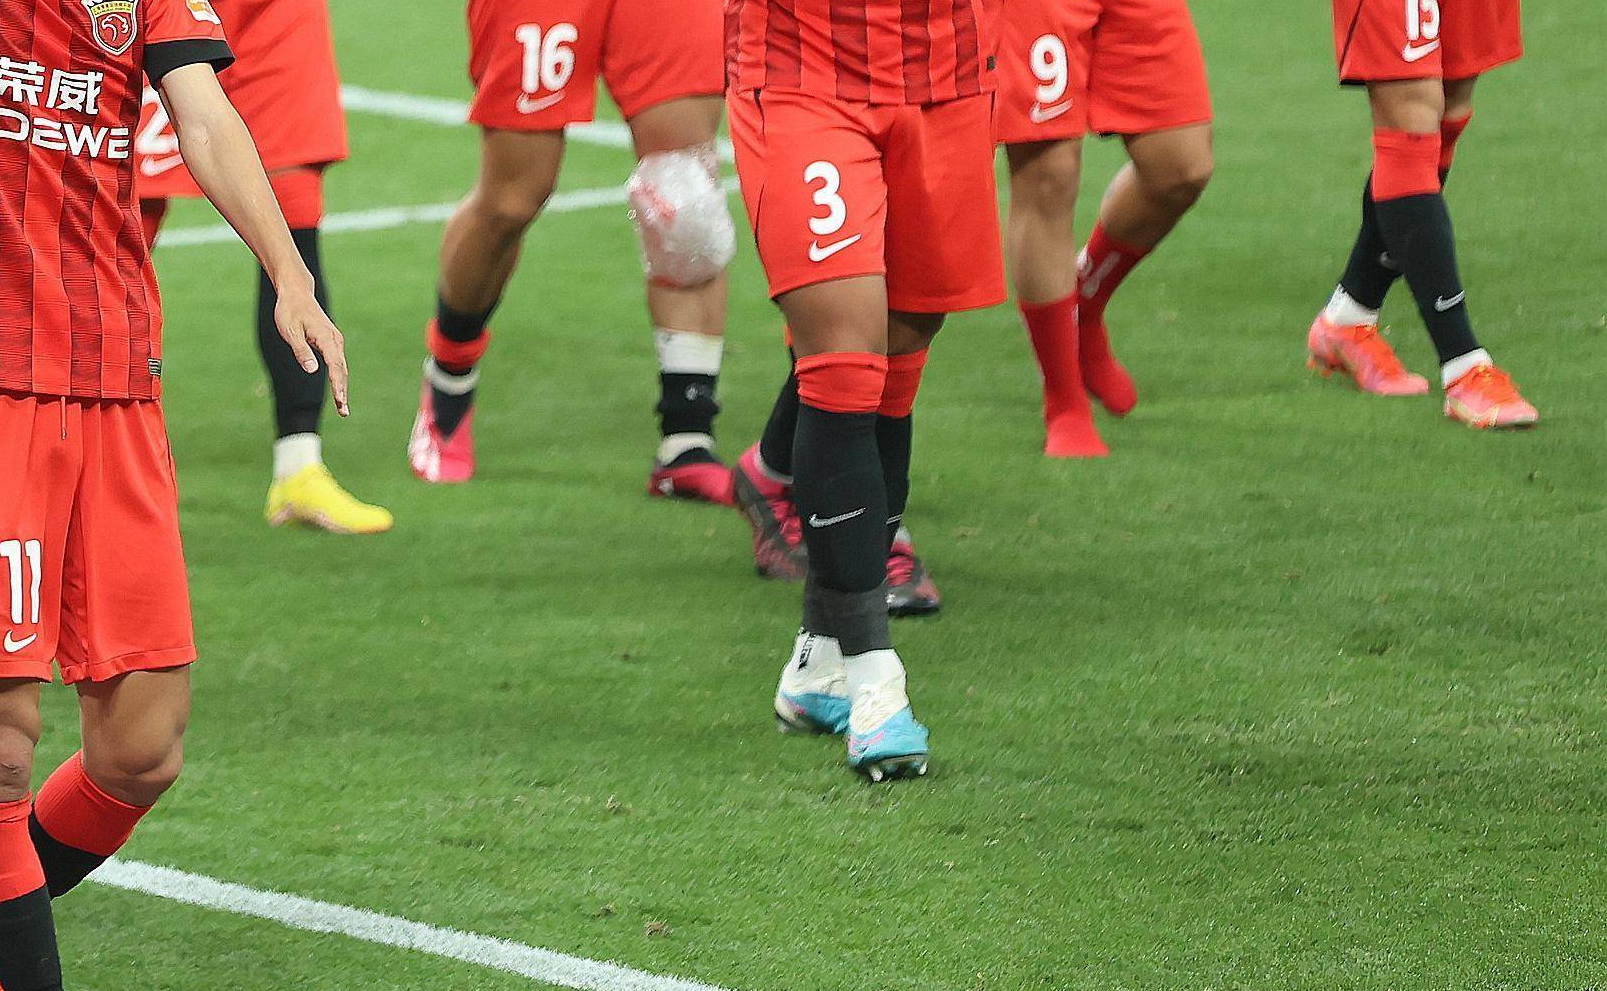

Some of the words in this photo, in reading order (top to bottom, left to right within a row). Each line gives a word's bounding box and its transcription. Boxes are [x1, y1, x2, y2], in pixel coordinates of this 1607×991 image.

[515, 22, 578, 94] 16
[1030, 33, 1068, 103] 9
[803, 160, 846, 235] 3
[0, 539, 42, 624] 11
